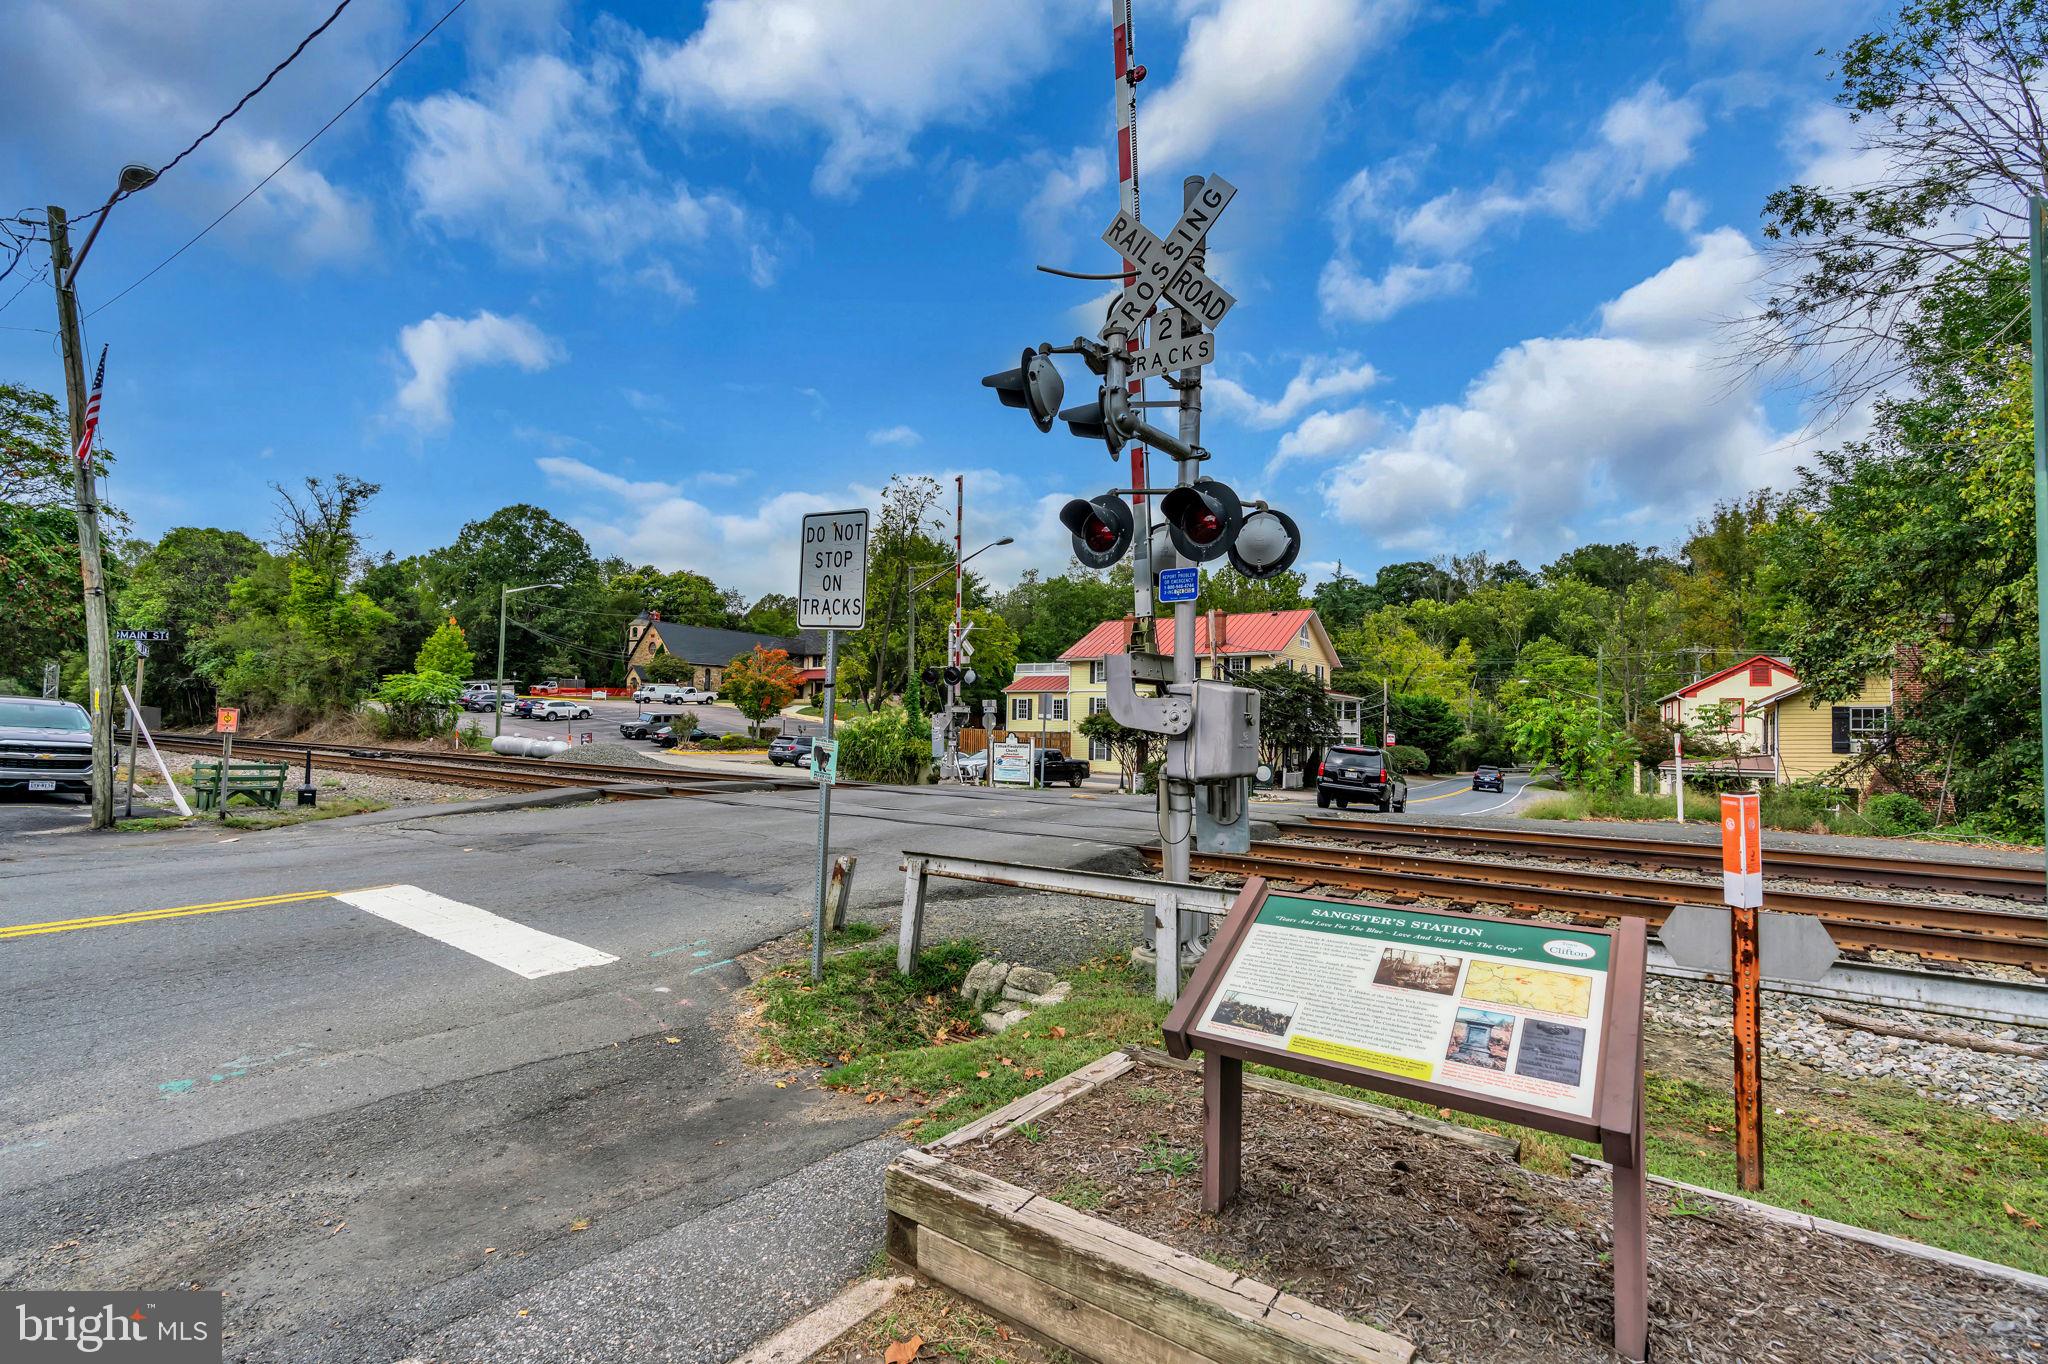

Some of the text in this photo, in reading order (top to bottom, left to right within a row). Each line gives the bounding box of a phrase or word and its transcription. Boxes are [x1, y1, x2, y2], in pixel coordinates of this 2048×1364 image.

[1108, 217, 1226, 321] RAIL ROAD
[1158, 317, 1172, 341] 2
[1136, 340, 1209, 373] RACKS
[806, 523, 863, 543] DO NOT
[815, 551, 853, 569] STOP
[822, 574, 842, 592] ON
[803, 598, 861, 616] TRACKS
[120, 631, 164, 640] MAIN ST
[1311, 908, 1484, 937] SANGSTER'S STATION
[1315, 920, 1333, 928] Love
[1392, 930, 1412, 938] Love
[1434, 936, 1456, 944] Tears
[1476, 941, 1493, 949] The
[1549, 946, 1588, 958] Clifton
